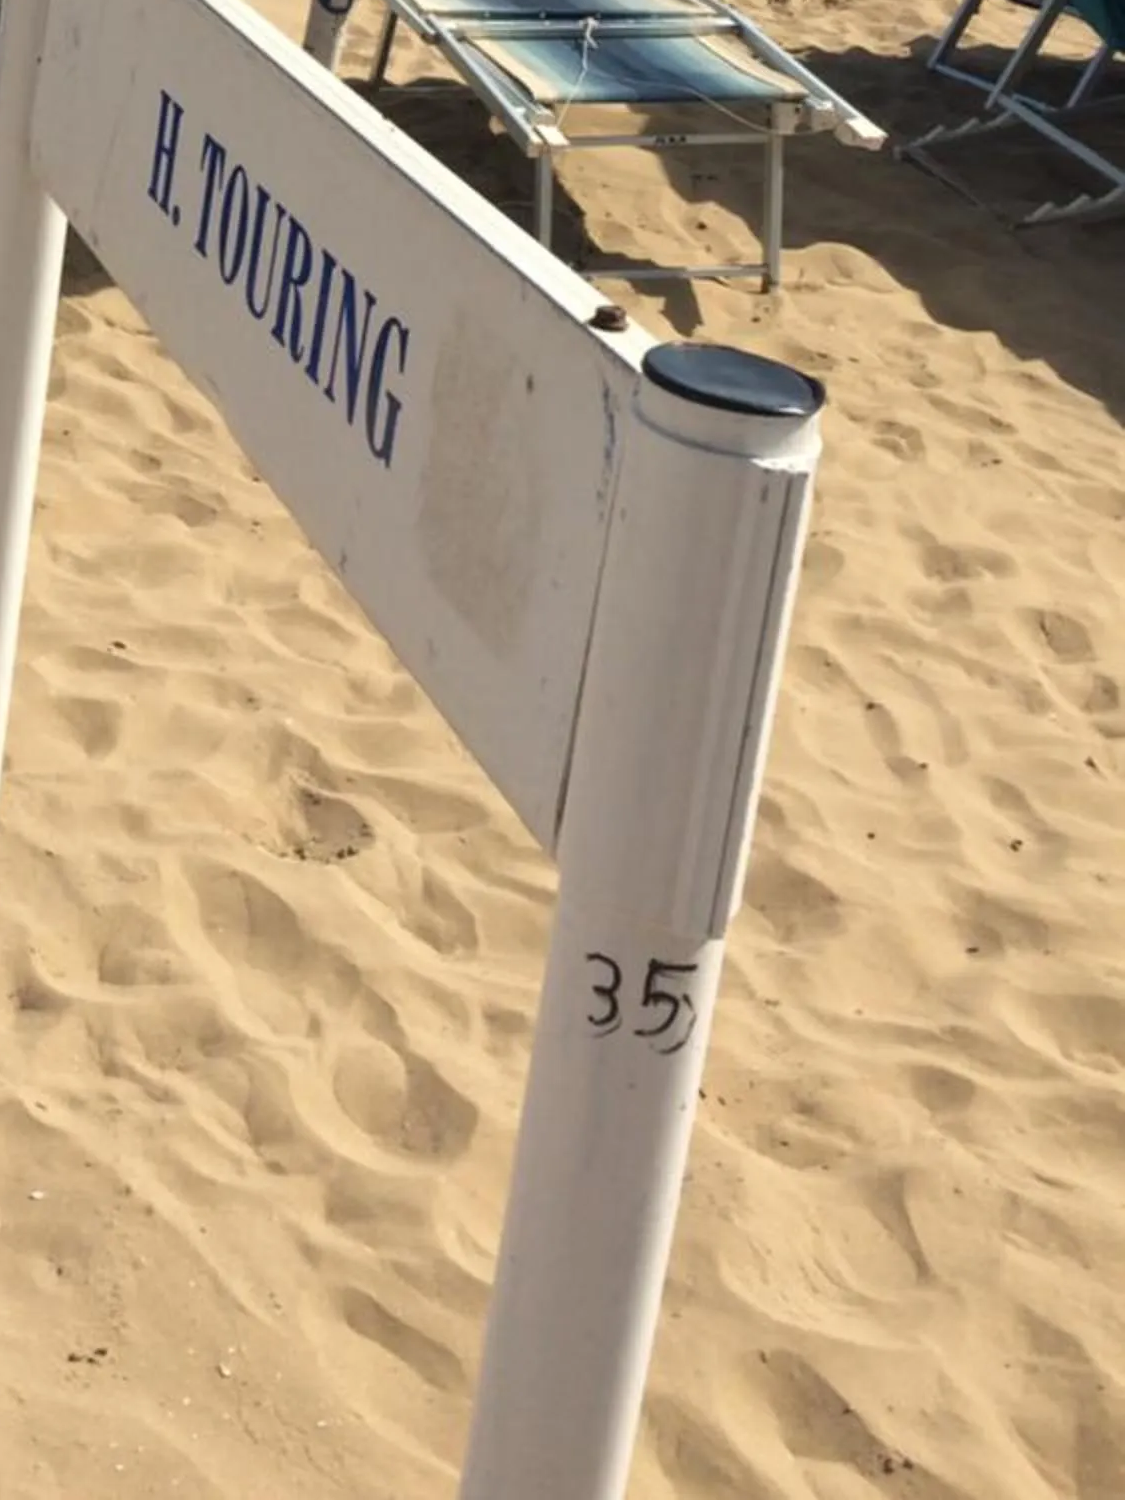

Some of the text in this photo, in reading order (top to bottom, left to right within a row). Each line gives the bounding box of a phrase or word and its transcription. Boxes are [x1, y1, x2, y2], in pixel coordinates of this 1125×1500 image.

[147, 88, 410, 470] H. TOURING
[585, 951, 698, 1052] 35
